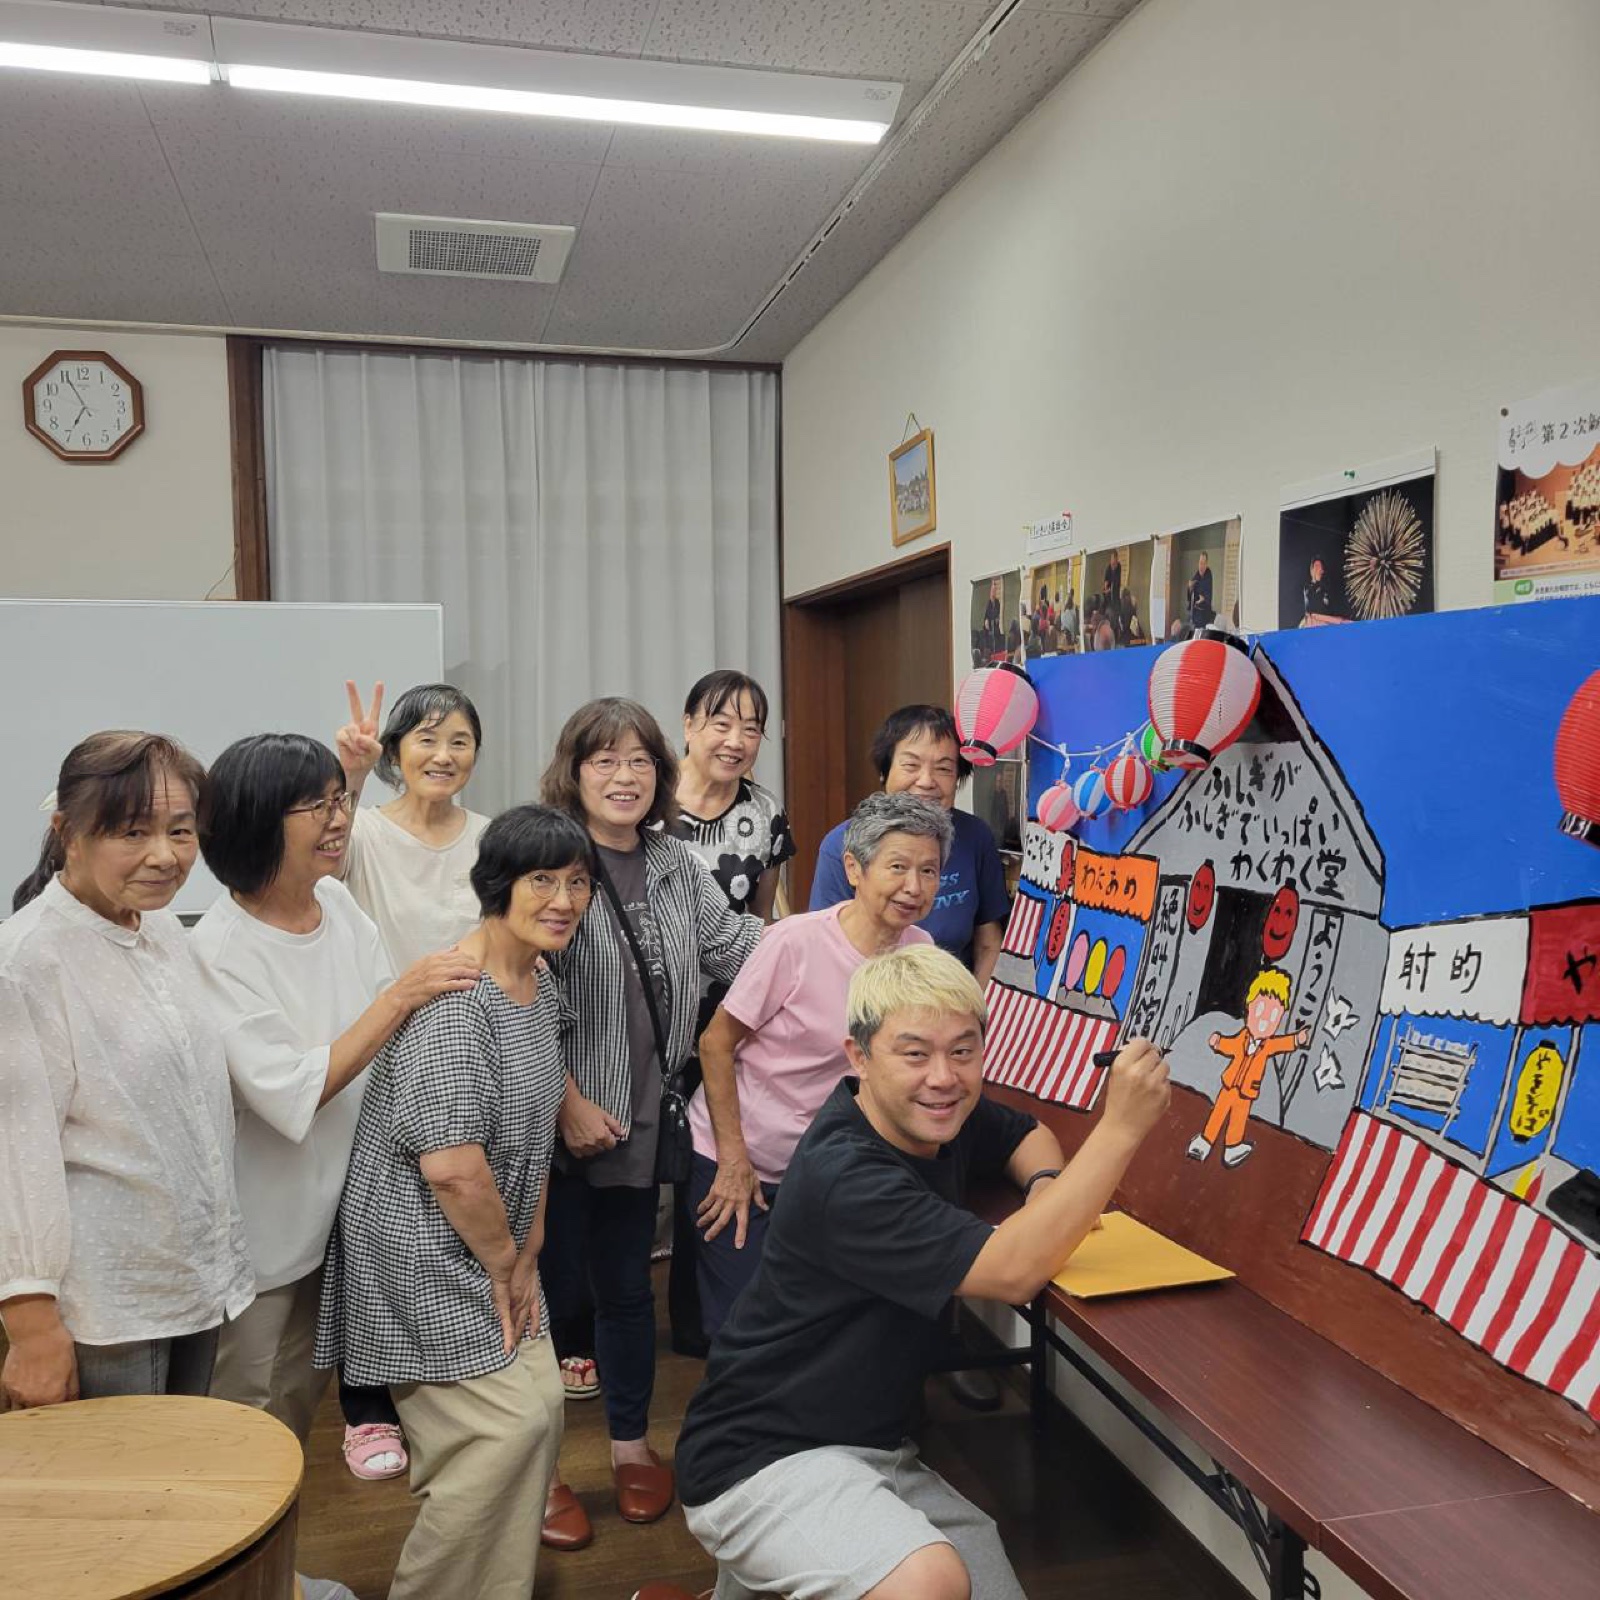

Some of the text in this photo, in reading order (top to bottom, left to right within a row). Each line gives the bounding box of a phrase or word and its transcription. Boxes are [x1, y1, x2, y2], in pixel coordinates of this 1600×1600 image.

[77, 367, 90, 381] 12
[46, 383, 59, 396] 10
[111, 383, 121, 397] 2
[43, 399, 52, 412] 9
[117, 400, 126, 415] 3
[49, 416, 59, 430] 8
[64, 429, 72, 442] 7
[82, 432, 92, 447] 6
[101, 430, 110, 443] 5
[1204, 751, 1302, 807] ふしぎが
[1178, 796, 1340, 849] ふしぎでいっぱい
[1230, 849, 1347, 901] わくわく堂
[1399, 942, 1482, 994] 射的
[1563, 945, 1597, 996] や
